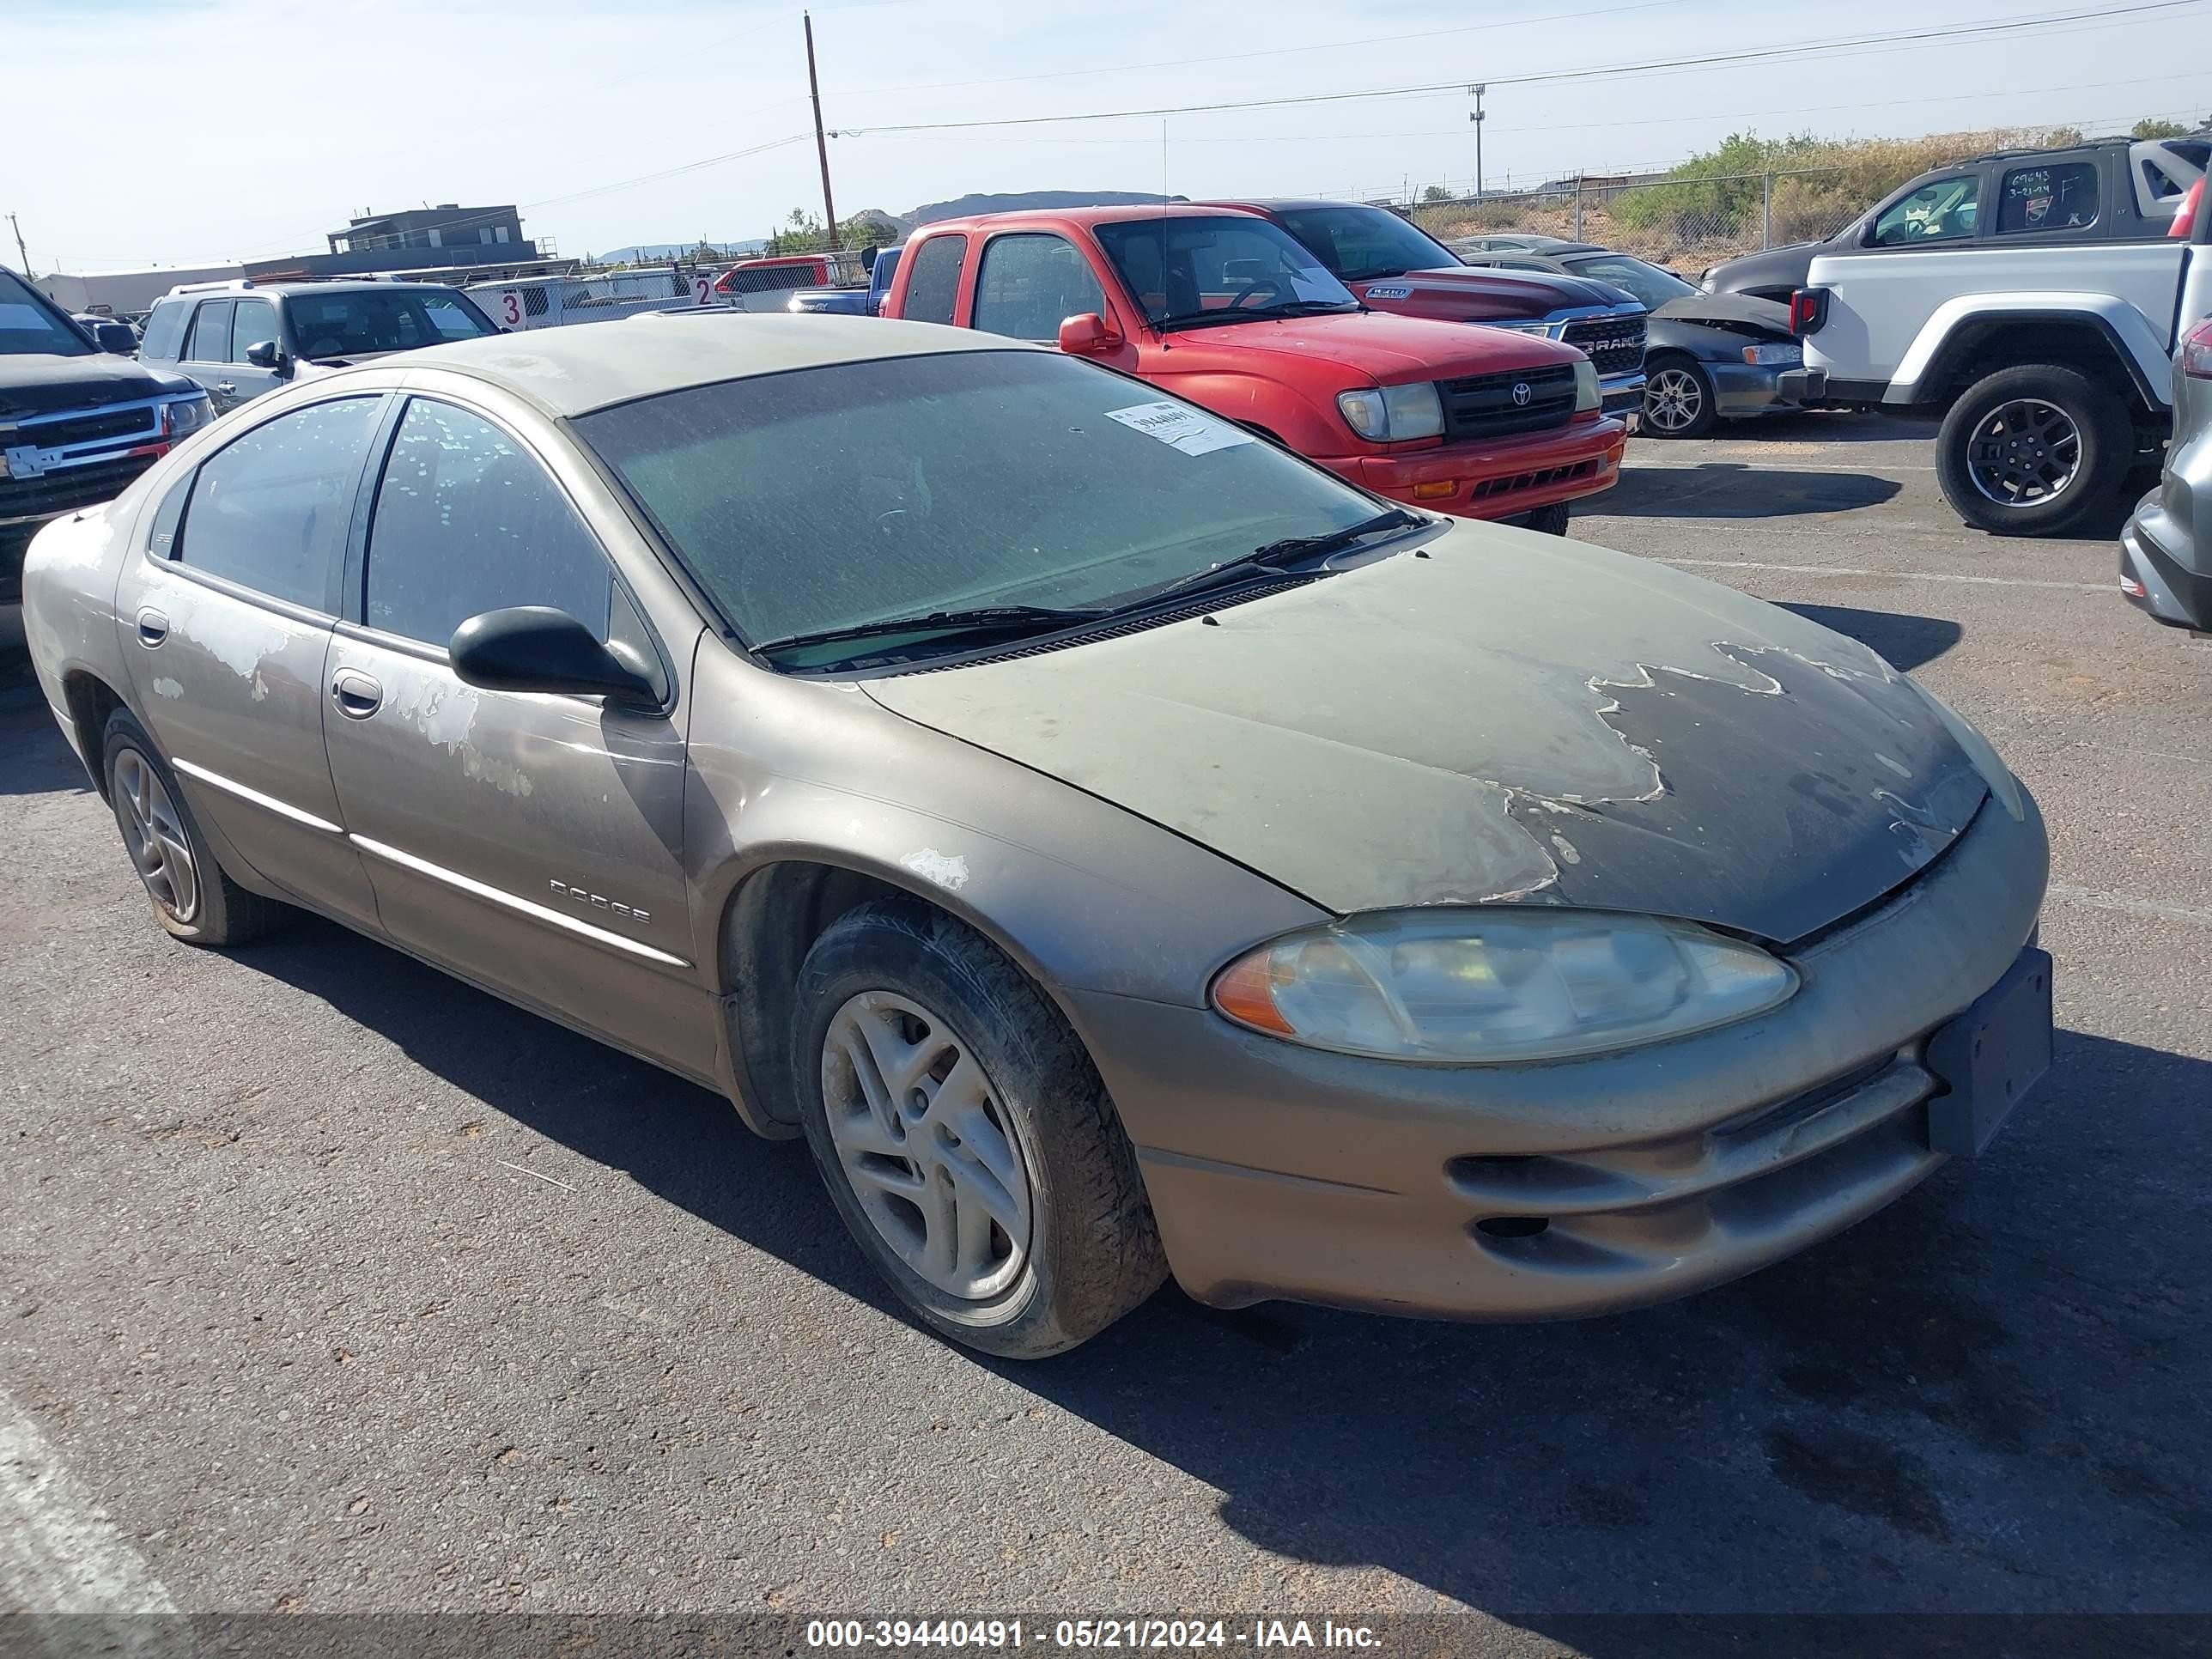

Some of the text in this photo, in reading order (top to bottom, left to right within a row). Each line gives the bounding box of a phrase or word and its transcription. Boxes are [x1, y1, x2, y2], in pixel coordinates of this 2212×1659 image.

[696, 279, 712, 306] 2
[502, 295, 520, 325] 3
[1595, 337, 1636, 350] RAM
[1133, 410, 1194, 429] 39440491
[550, 878, 652, 924] DODGE
